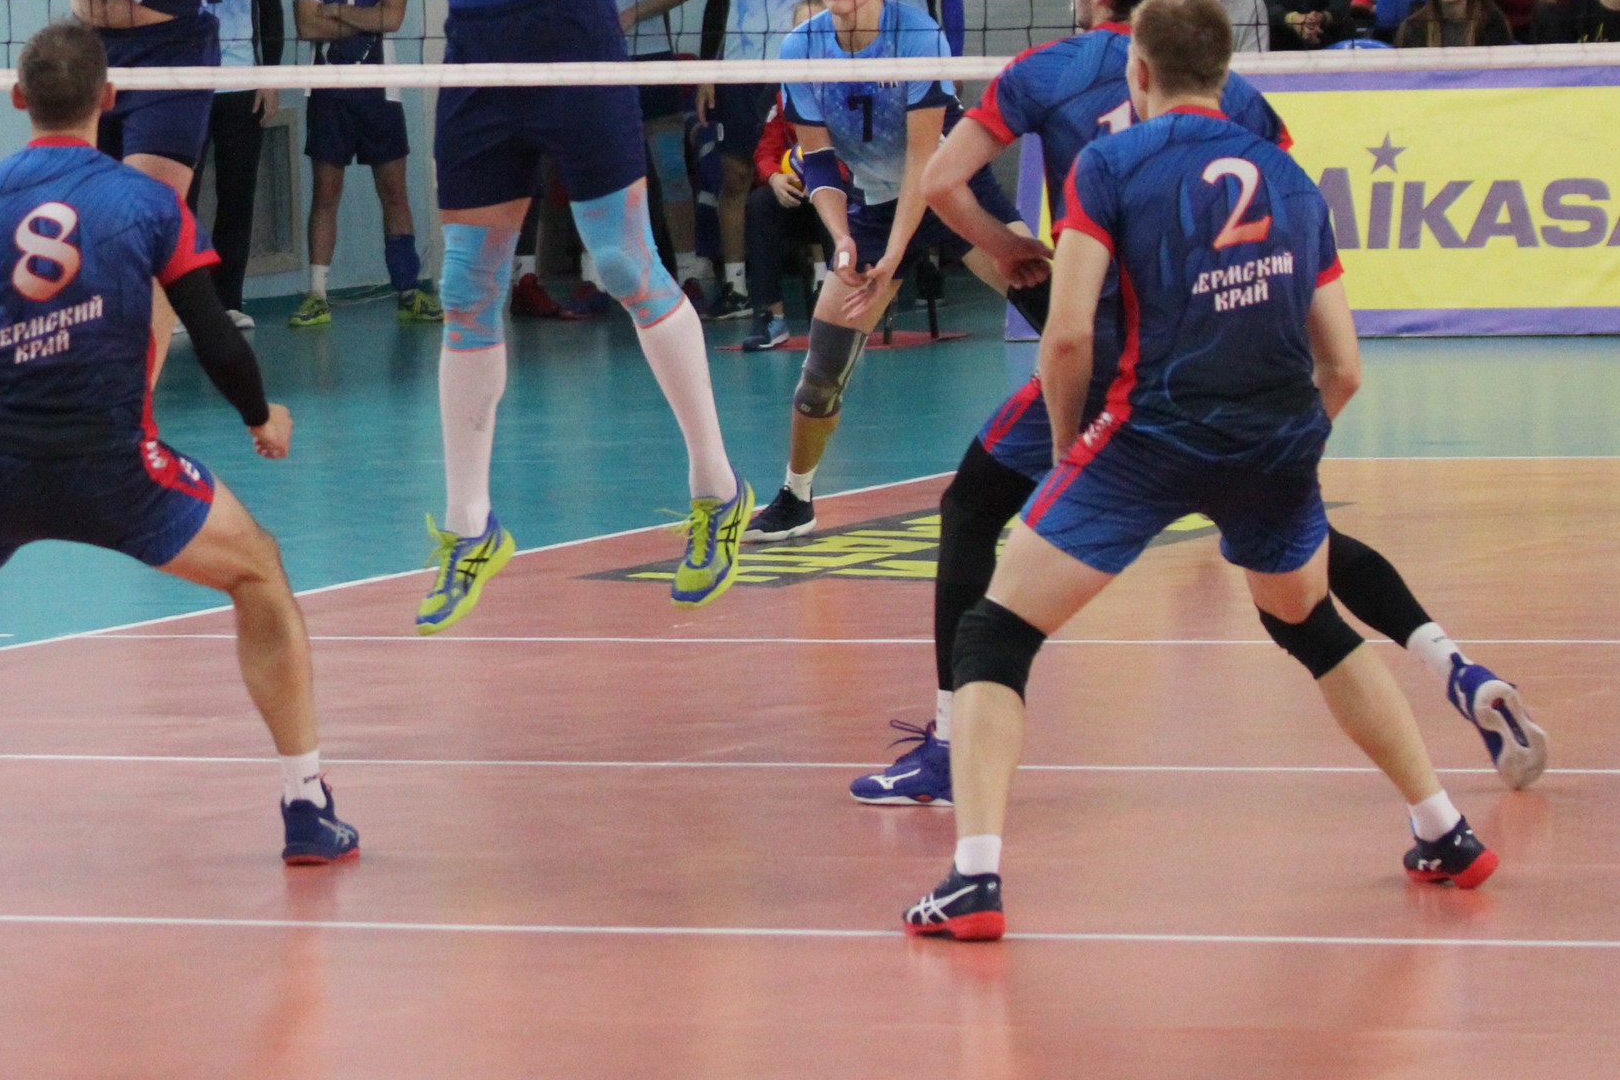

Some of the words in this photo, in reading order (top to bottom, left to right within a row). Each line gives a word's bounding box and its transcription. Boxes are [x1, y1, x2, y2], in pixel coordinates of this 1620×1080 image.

[1202, 156, 1272, 251] 2
[1318, 166, 1620, 250] IKAS
[12, 201, 81, 302] 8
[1214, 279, 1269, 311] КРАЙ
[15, 329, 70, 364] КРАЙ
